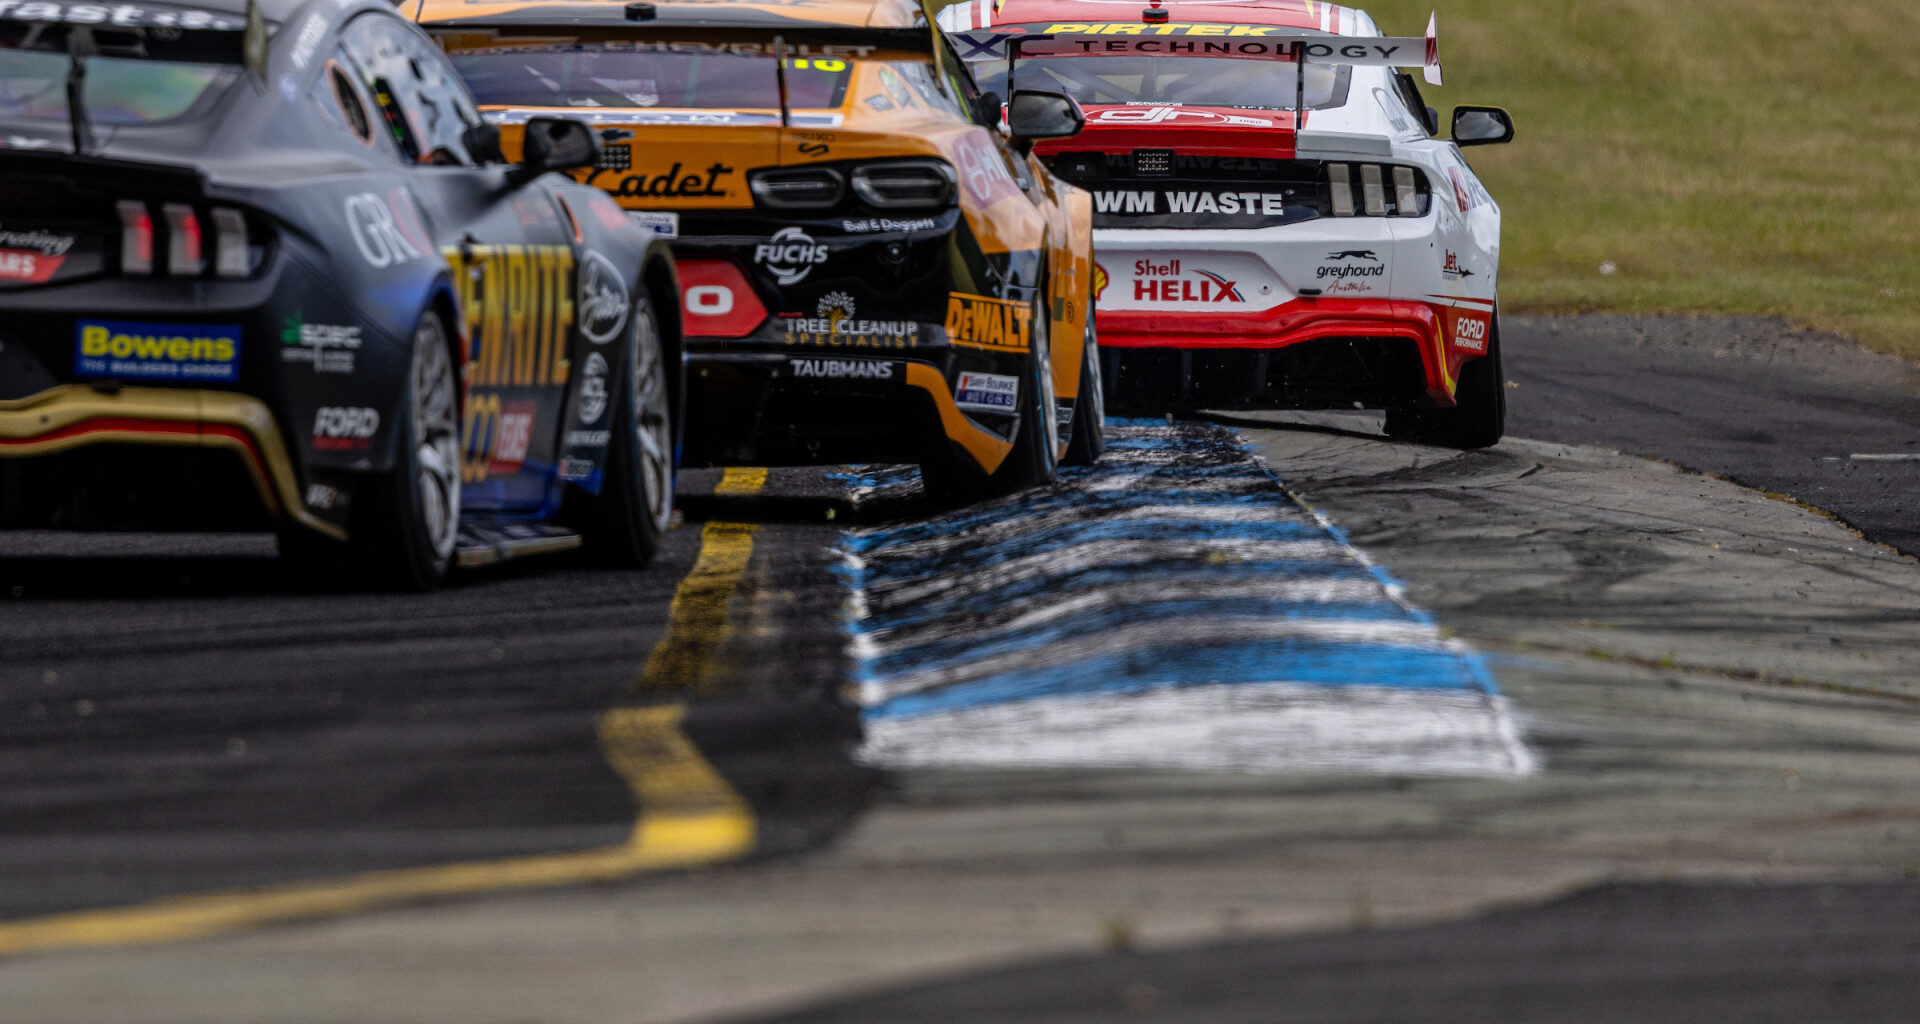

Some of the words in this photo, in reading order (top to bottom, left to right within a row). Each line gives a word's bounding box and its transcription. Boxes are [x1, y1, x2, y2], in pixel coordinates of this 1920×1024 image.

[1043, 23, 1281, 37] PIRTEK
[1075, 40, 1400, 60] TECHNOLOGY
[1093, 191, 1155, 213] WM
[1165, 191, 1284, 216] WASTE
[754, 245, 829, 264] FUCHS
[1443, 248, 1458, 270] Jet
[1134, 260, 1180, 276] Shell
[1316, 264, 1385, 279] greyhound
[1133, 279, 1241, 303] HELIX
[786, 318, 830, 333] TREE
[836, 319, 918, 336] CLEANUP
[1457, 317, 1485, 339] FORD
[82, 325, 236, 361] Bowens
[785, 332, 918, 349] SPECIALIST
[790, 359, 893, 378] TAUBMANS
[314, 407, 379, 437] FORD
